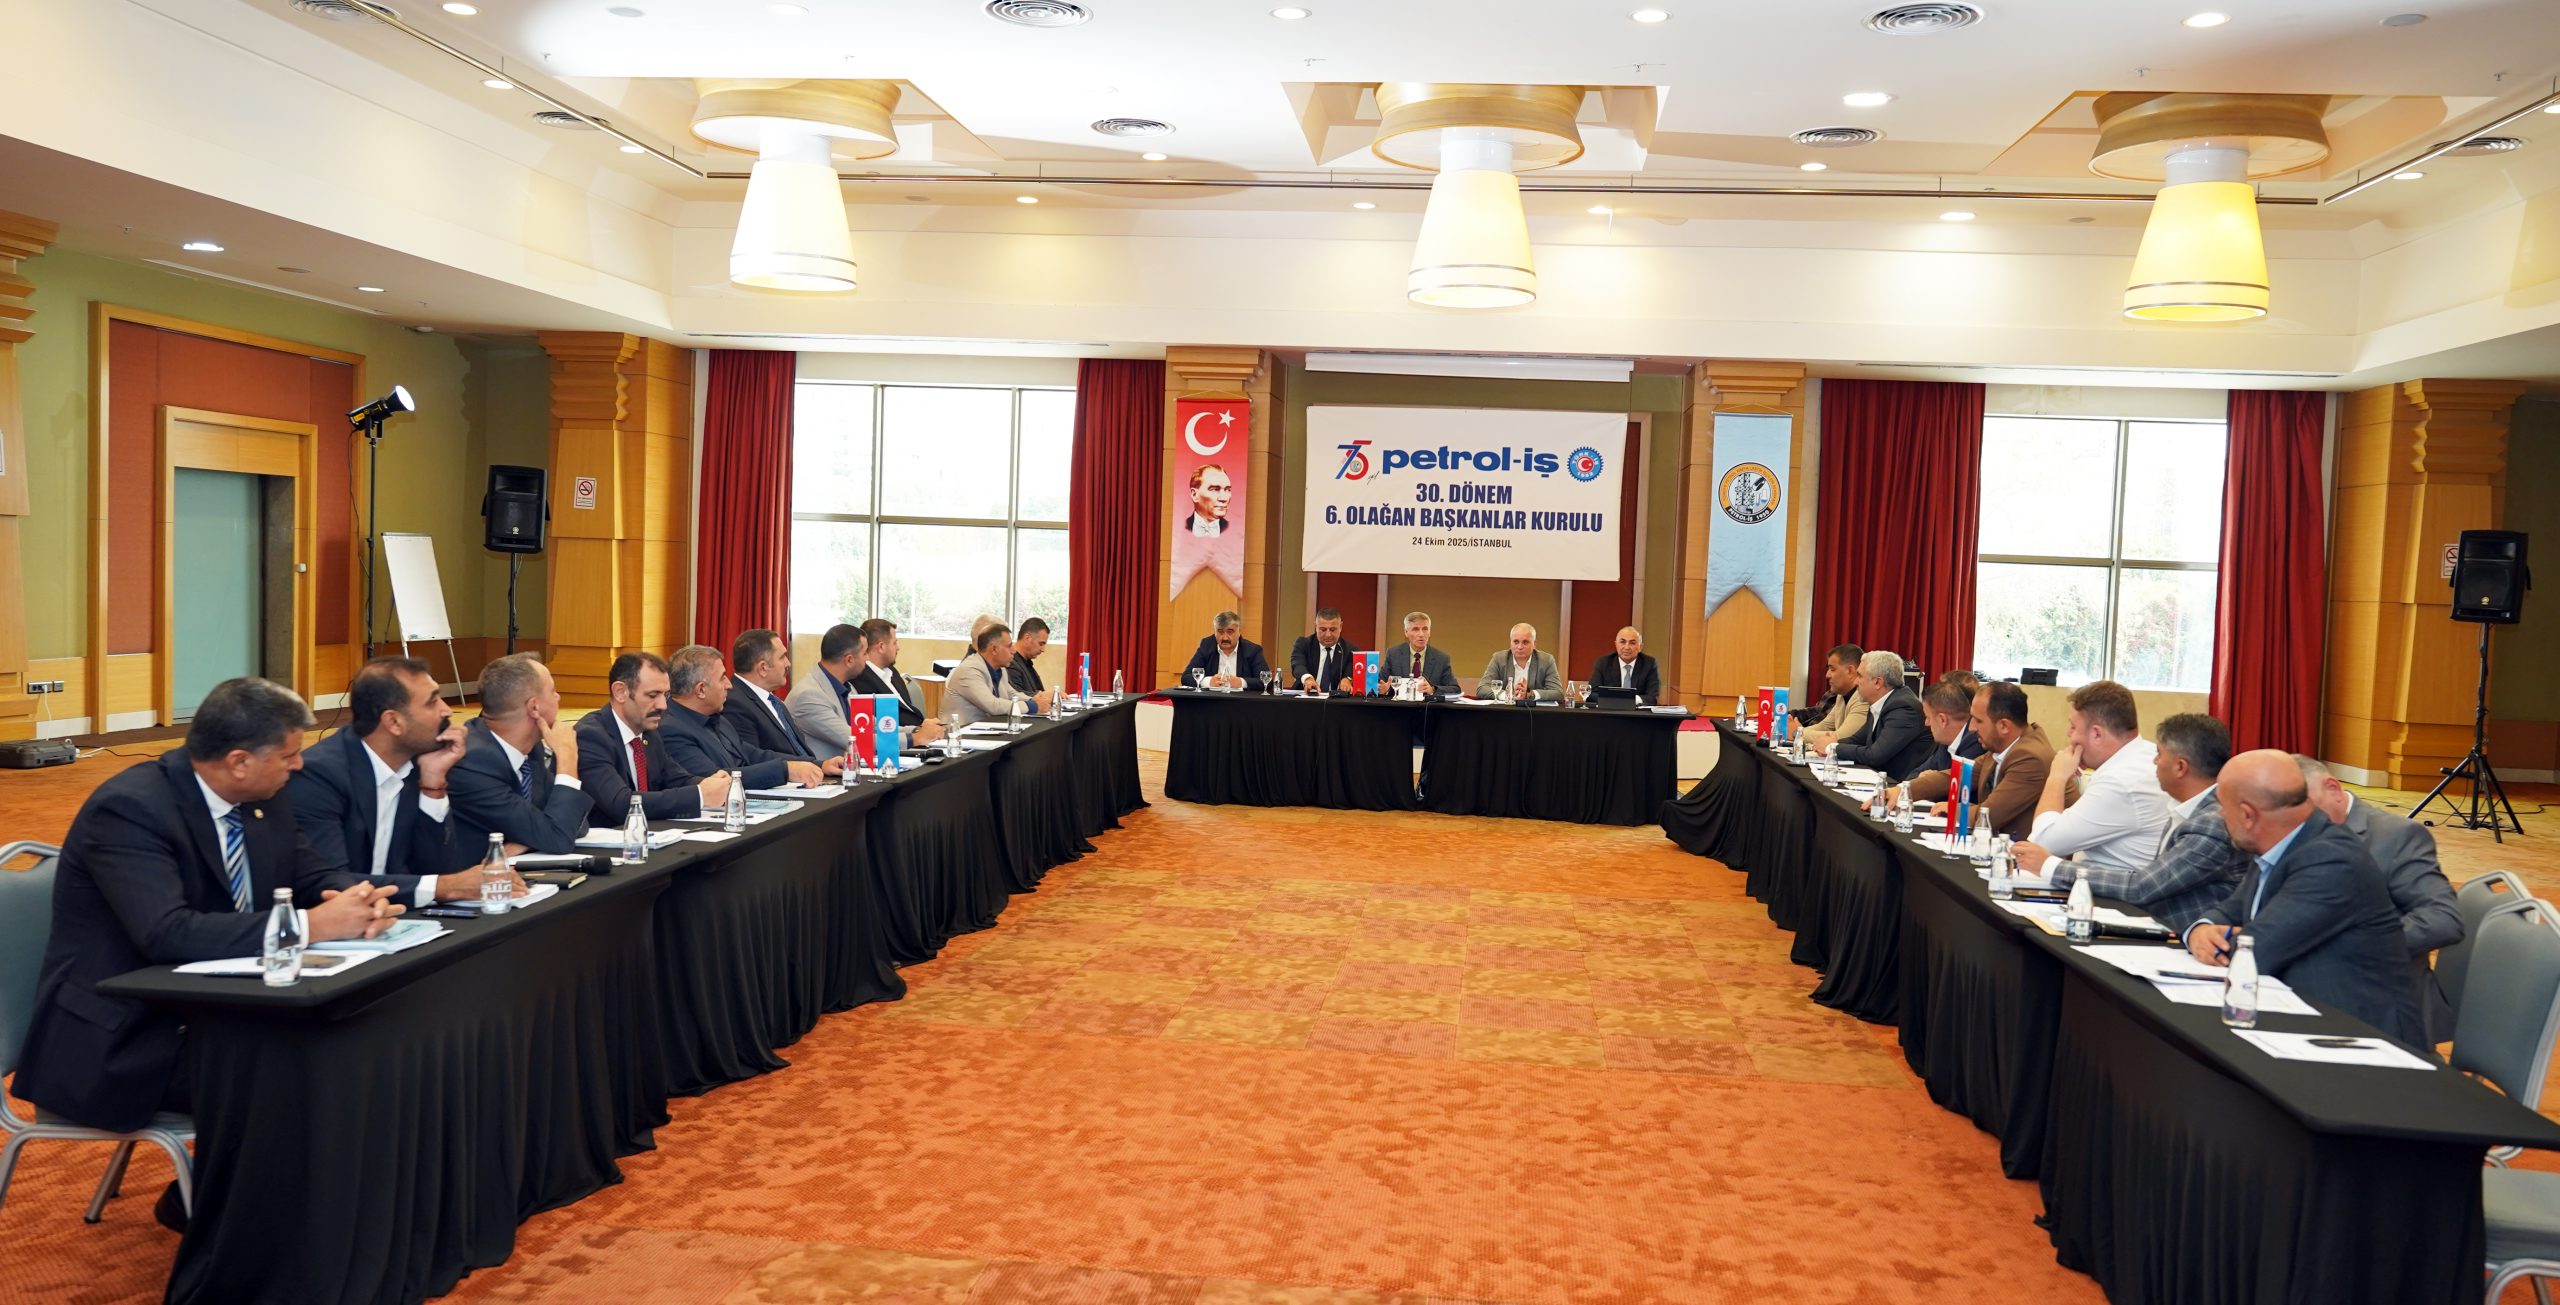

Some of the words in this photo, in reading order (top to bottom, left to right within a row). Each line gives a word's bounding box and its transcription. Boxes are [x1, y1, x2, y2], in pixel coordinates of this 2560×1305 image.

[1382, 446, 1559, 478] petrol-iş
[1416, 483, 1444, 502] 30.
[1448, 481, 1512, 504] DÖNEM
[1325, 505, 1341, 524] 6.
[1346, 503, 1416, 526] OLAĞAN
[1420, 508, 1526, 531] BAŞKANLAR
[1531, 511, 1603, 532] KURULU
[1412, 537, 1422, 546] 24
[1425, 537, 1445, 546] Ekim
[1447, 537, 1512, 548] 2025/İSTANBUL
